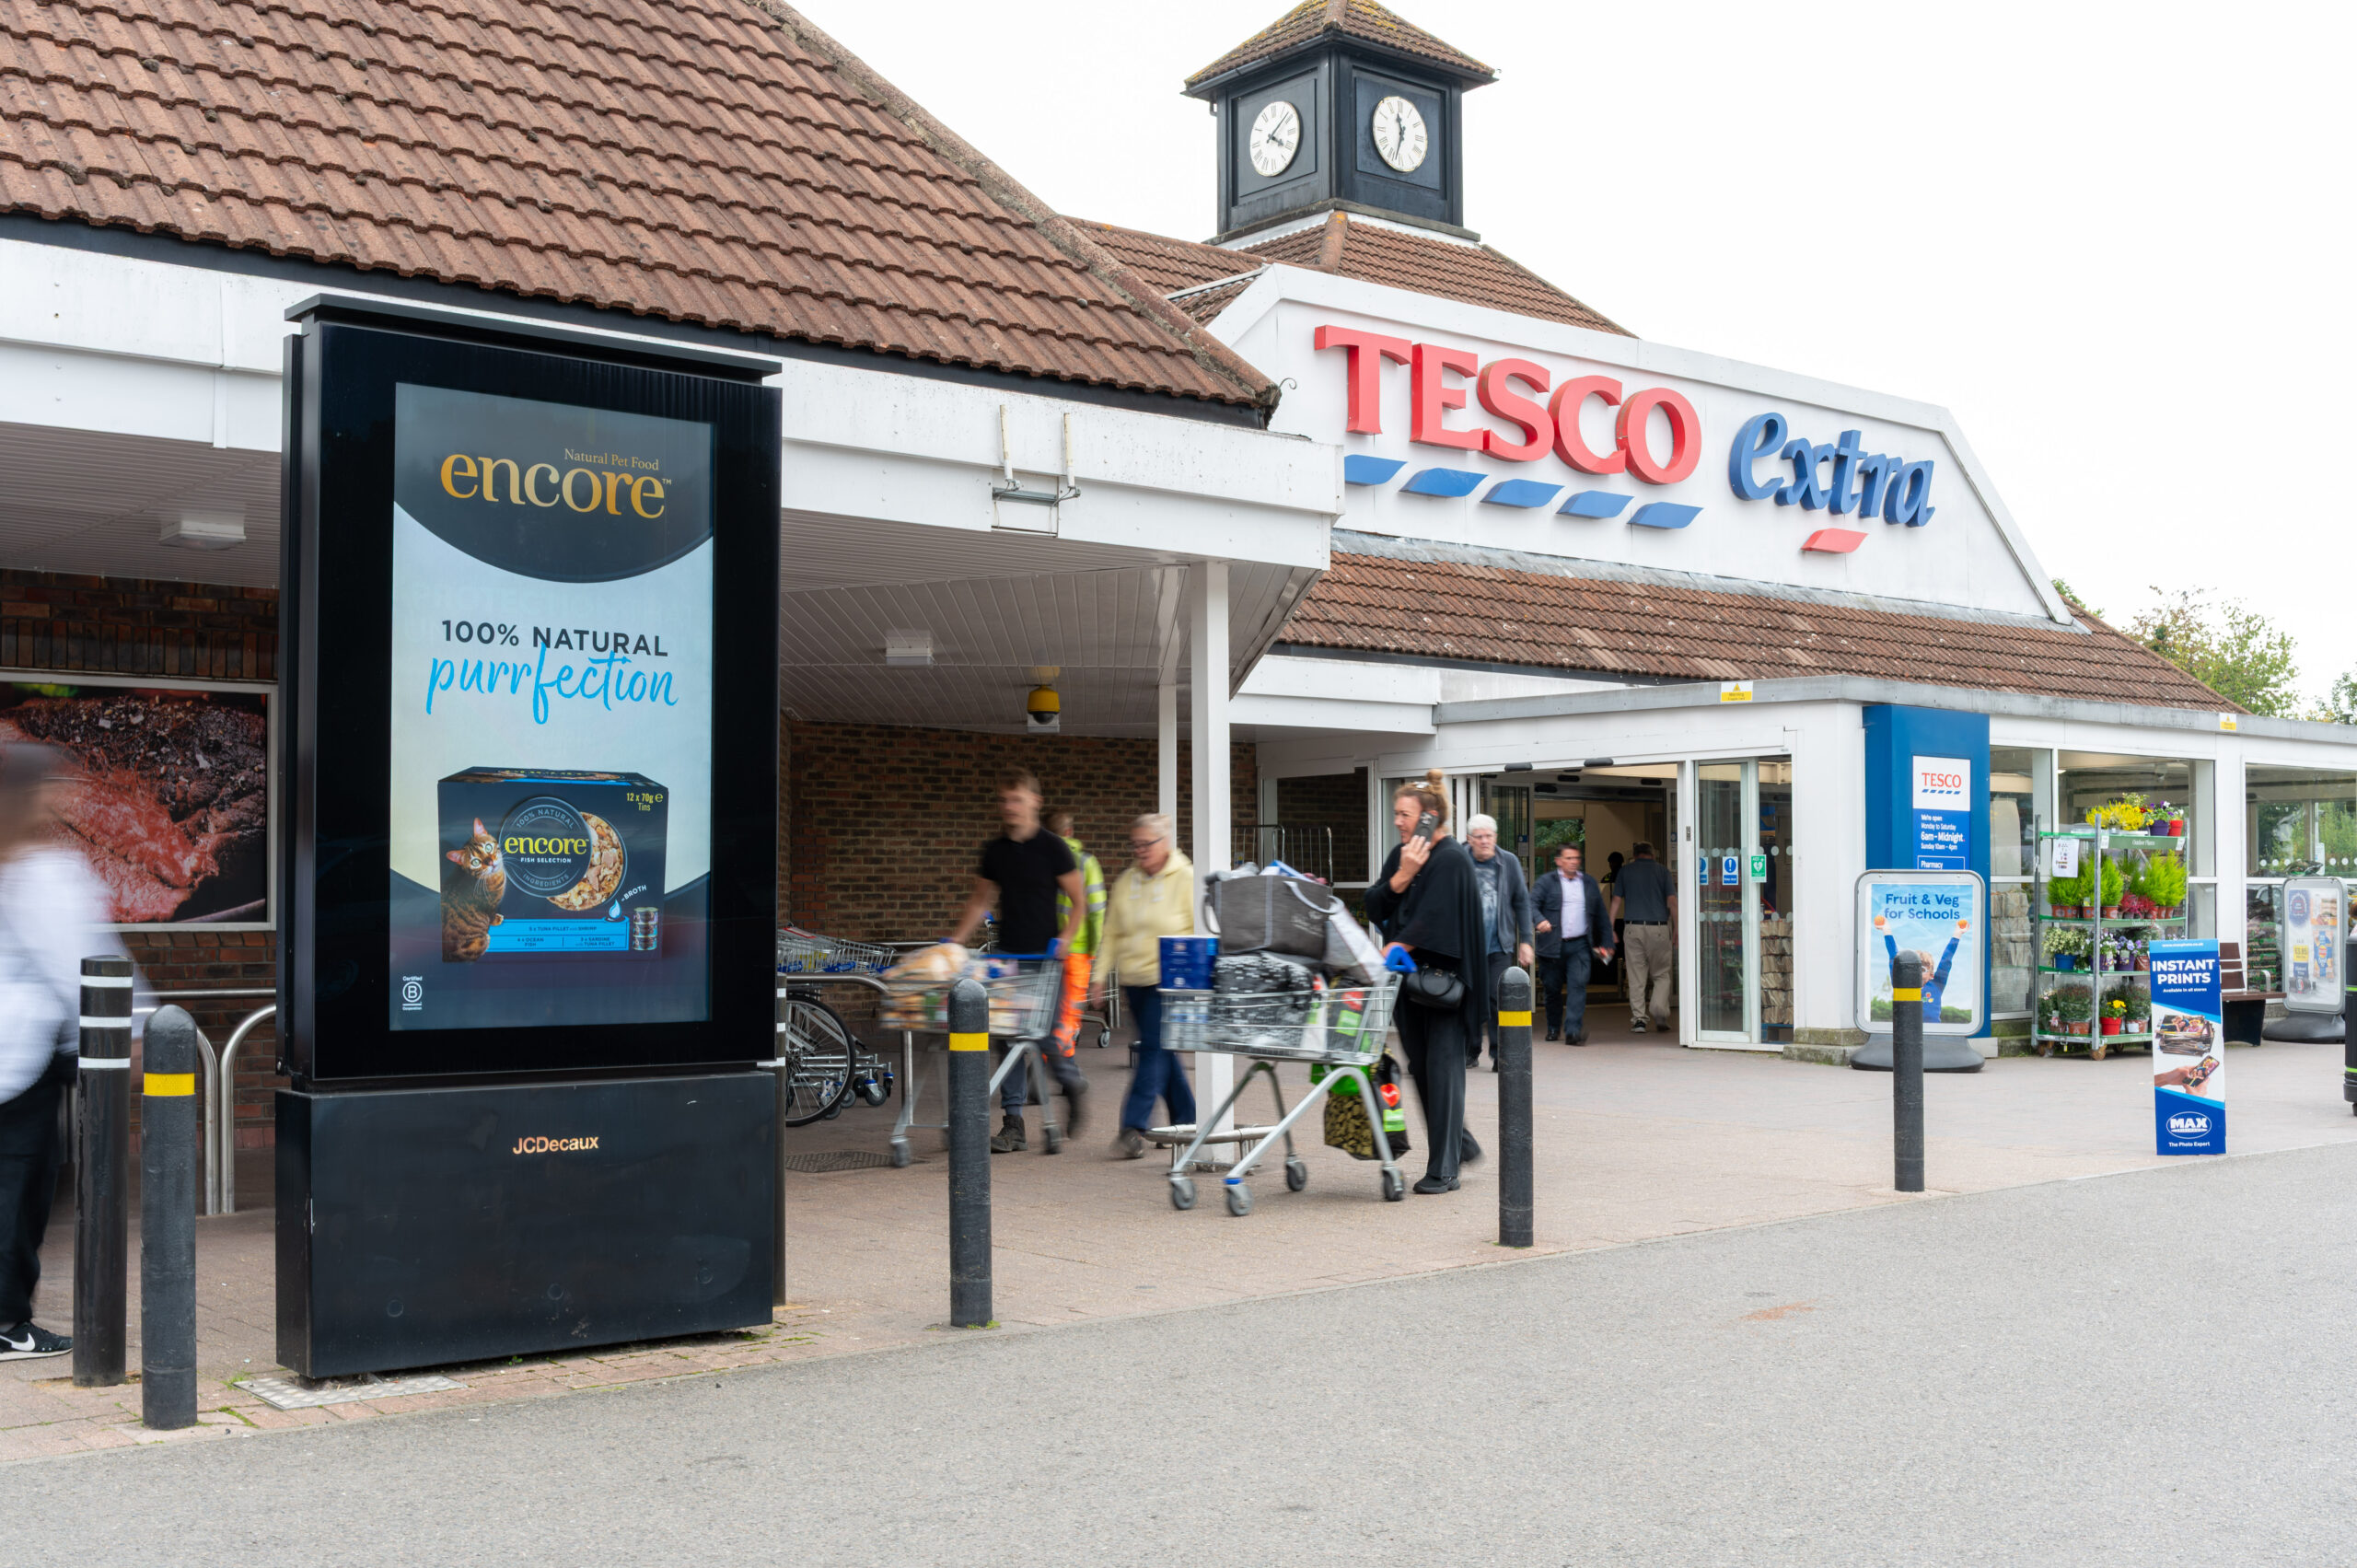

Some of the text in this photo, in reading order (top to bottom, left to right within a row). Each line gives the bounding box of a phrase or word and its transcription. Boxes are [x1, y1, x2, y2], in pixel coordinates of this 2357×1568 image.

[1315, 324, 1935, 528] TESCO extra
[564, 448, 659, 471] Natural Pet Food
[442, 620, 668, 657] 100% NATURAL
[426, 642, 679, 725] purrfection
[1922, 772, 1962, 788] TESCO
[627, 793, 634, 801] 12
[642, 793, 653, 803] 70g
[638, 802, 651, 811] Tins
[517, 809, 574, 829] 100% NATURAL
[1921, 860, 1943, 869] Pharmacy
[523, 873, 569, 887] INGREDIENTS
[624, 885, 647, 899] BROTH
[1886, 893, 1959, 908] Fruit & Veg
[1884, 908, 1960, 919] for Schools
[2152, 959, 2215, 972] INSTANT
[2158, 972, 2211, 984] PRINTS
[2170, 1118, 2208, 1129] MAX
[513, 1136, 599, 1154] JCDecaux
